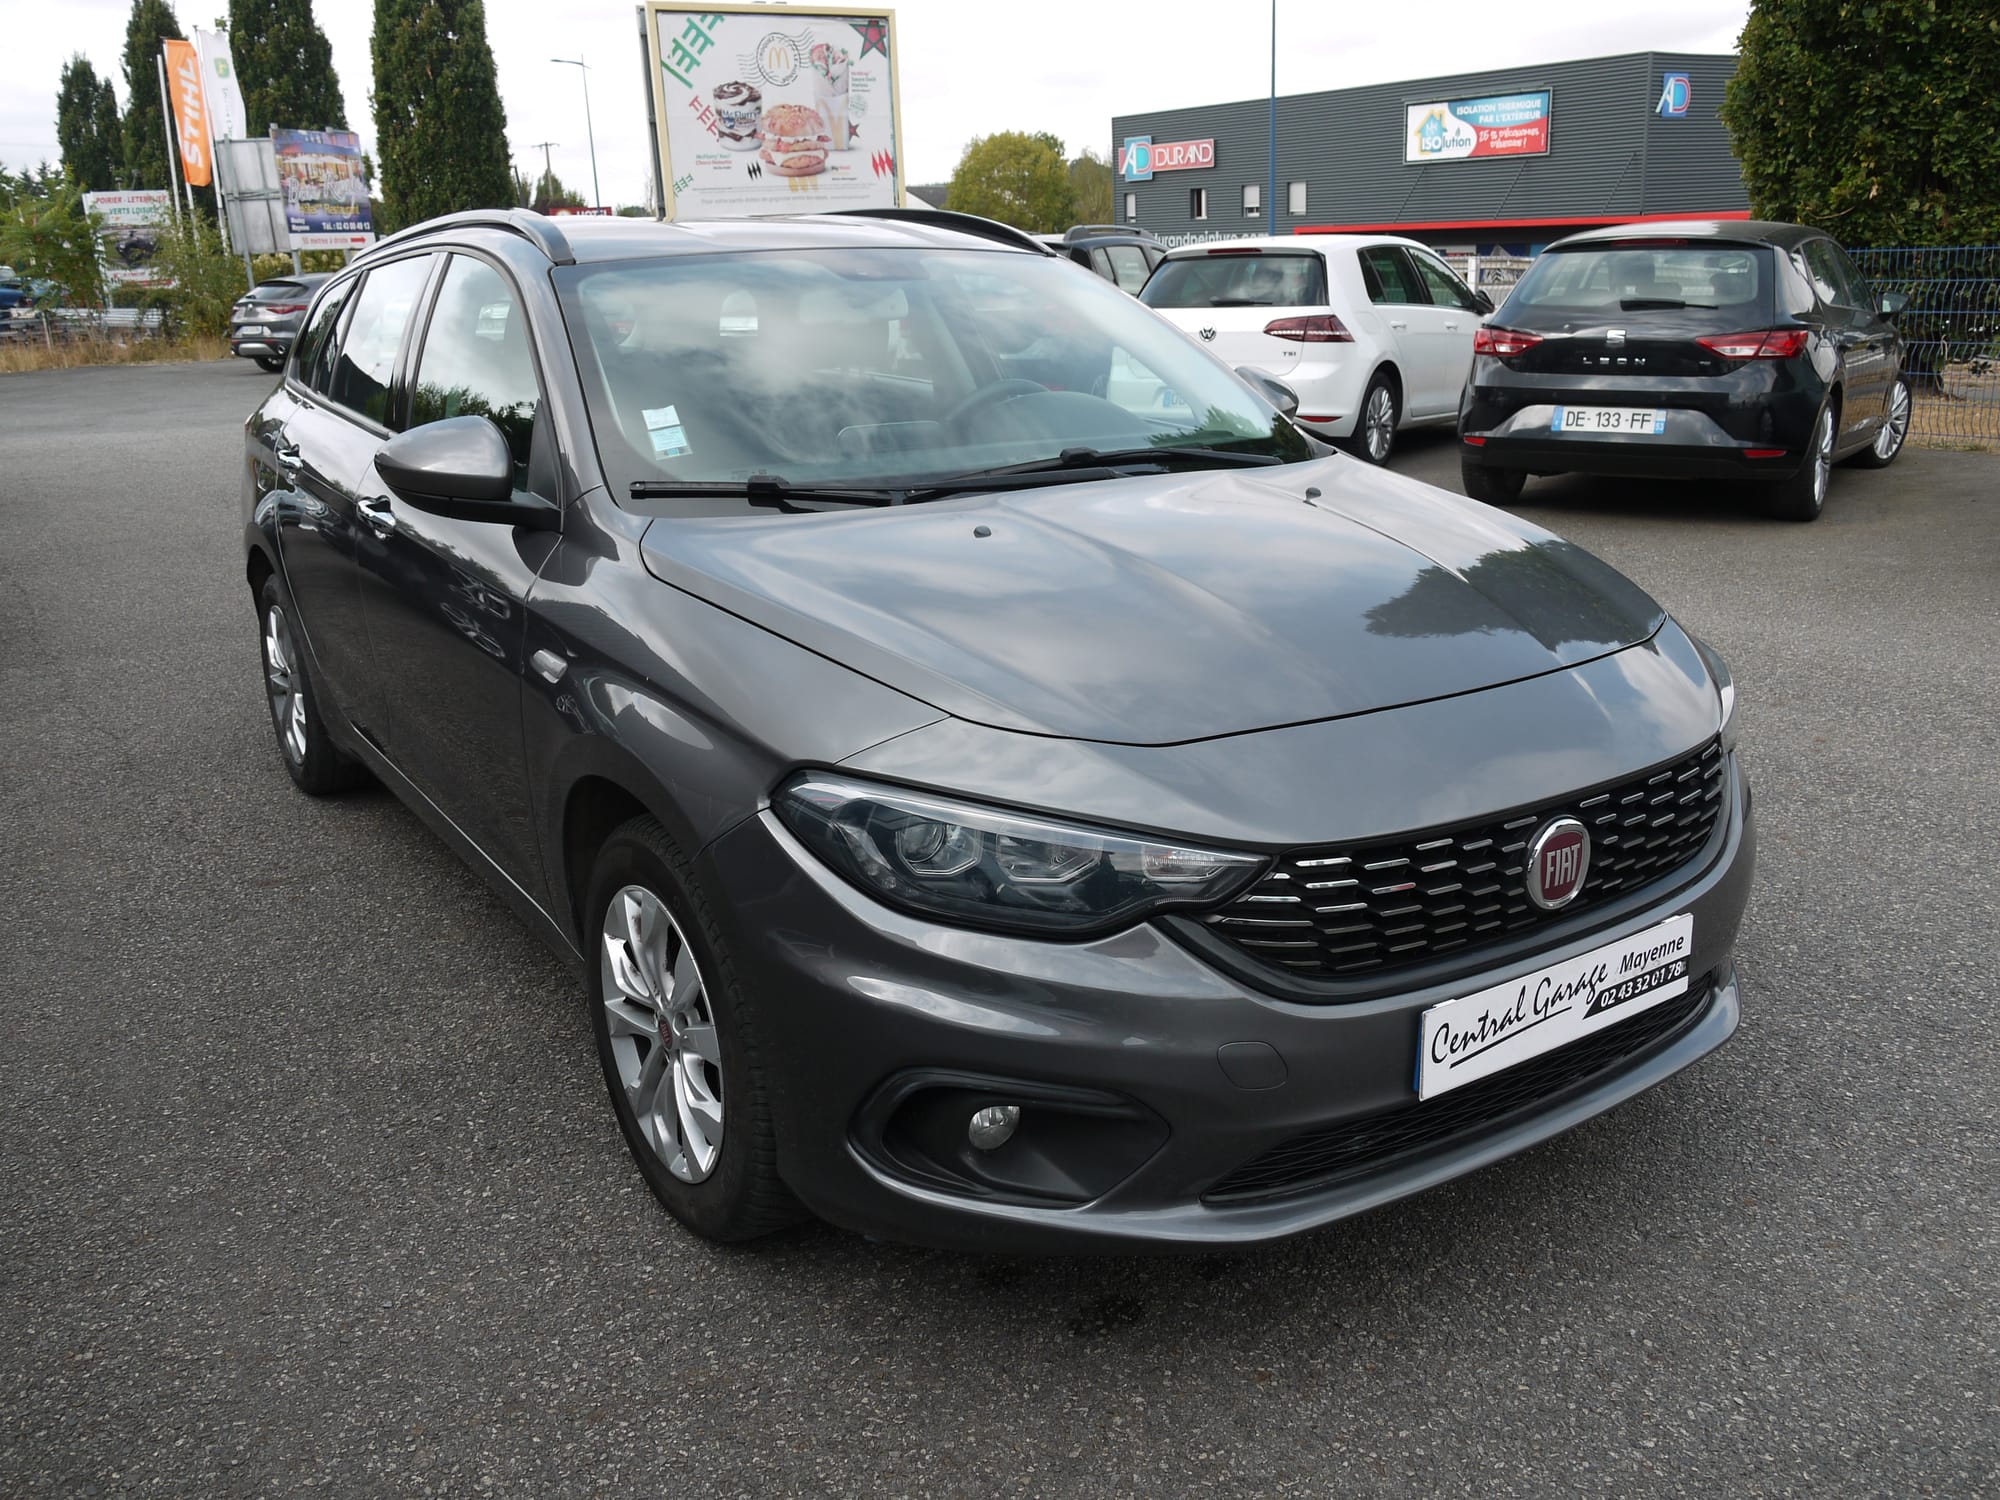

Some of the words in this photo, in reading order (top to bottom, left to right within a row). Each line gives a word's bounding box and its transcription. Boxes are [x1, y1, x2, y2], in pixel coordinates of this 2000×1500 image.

[1457, 103, 1496, 115] ISOLATION
[1498, 99, 1541, 111] THERMIQUE
[1655, 77, 1691, 113] AD
[178, 58, 203, 168] STIHL
[1480, 114, 1494, 124] PAR
[1156, 144, 1213, 166] DURAND
[1422, 136, 1471, 149] ISOlution
[96, 196, 122, 204] POIRIER
[1583, 357, 1646, 365] LEON
[1544, 843, 1581, 889] FIAT
[1619, 936, 1684, 974] Mayenne
[1601, 988, 1616, 1008] 02
[1618, 981, 1633, 999] 43
[1635, 974, 1650, 994] 32
[1651, 968, 1665, 986] 01
[1667, 961, 1682, 980] 78
[1431, 985, 1526, 1064] Central
[1533, 963, 1608, 1017] Garage
